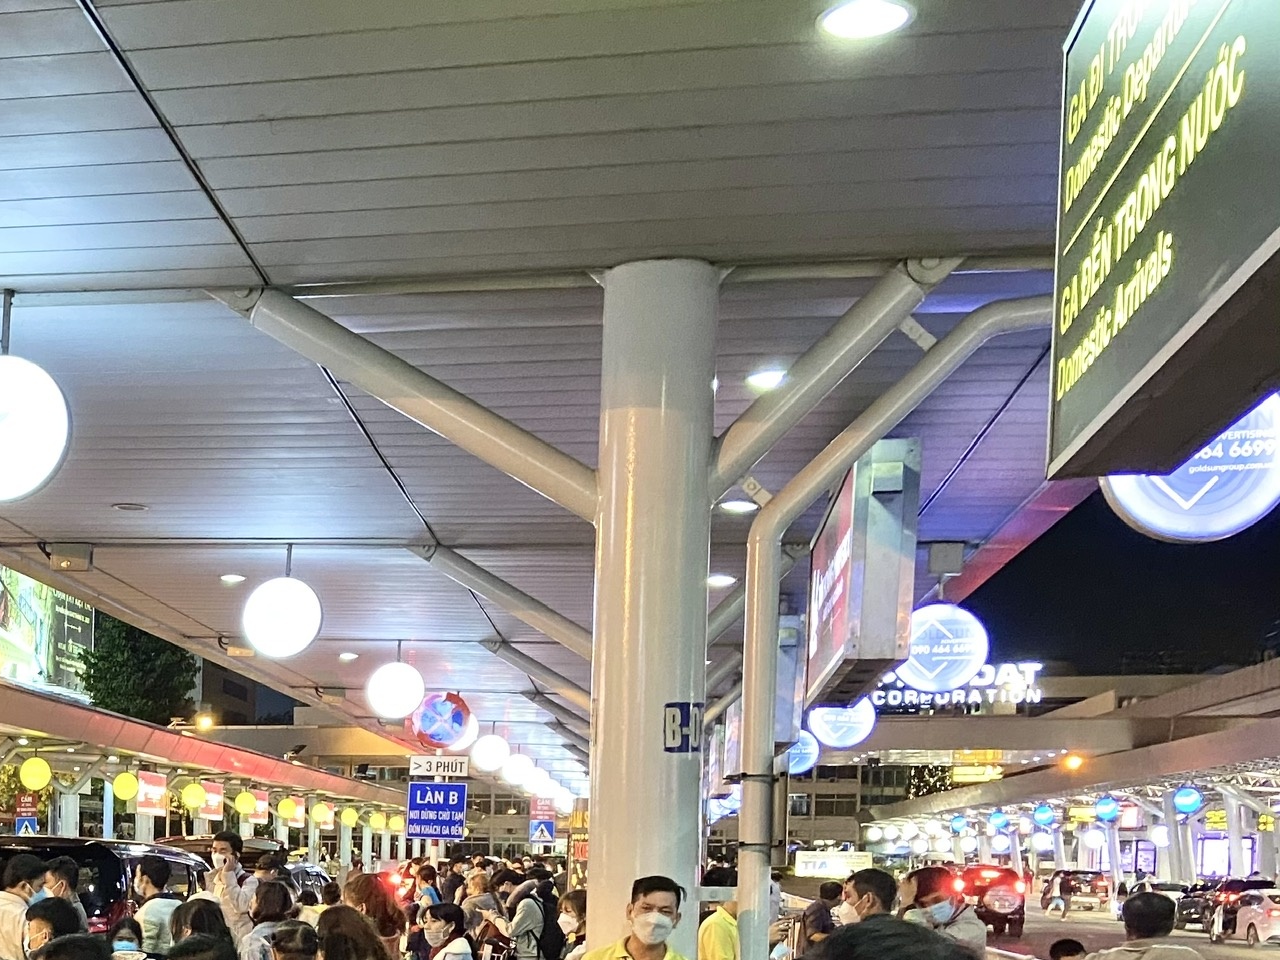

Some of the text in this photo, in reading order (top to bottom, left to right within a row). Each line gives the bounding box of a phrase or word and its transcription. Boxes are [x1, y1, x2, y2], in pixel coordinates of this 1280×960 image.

[1068, 78, 1087, 145] GA
[1060, 34, 1246, 336] GA ĐẾN TRONG NƯỚC
[1065, 94, 1121, 213] Domestic
[1057, 229, 1173, 402] Domestic Arrivals
[416, 786, 458, 805] LÀN B
[425, 760, 433, 773] 3
[436, 759, 465, 773] PHÚT
[441, 825, 450, 835] GA
